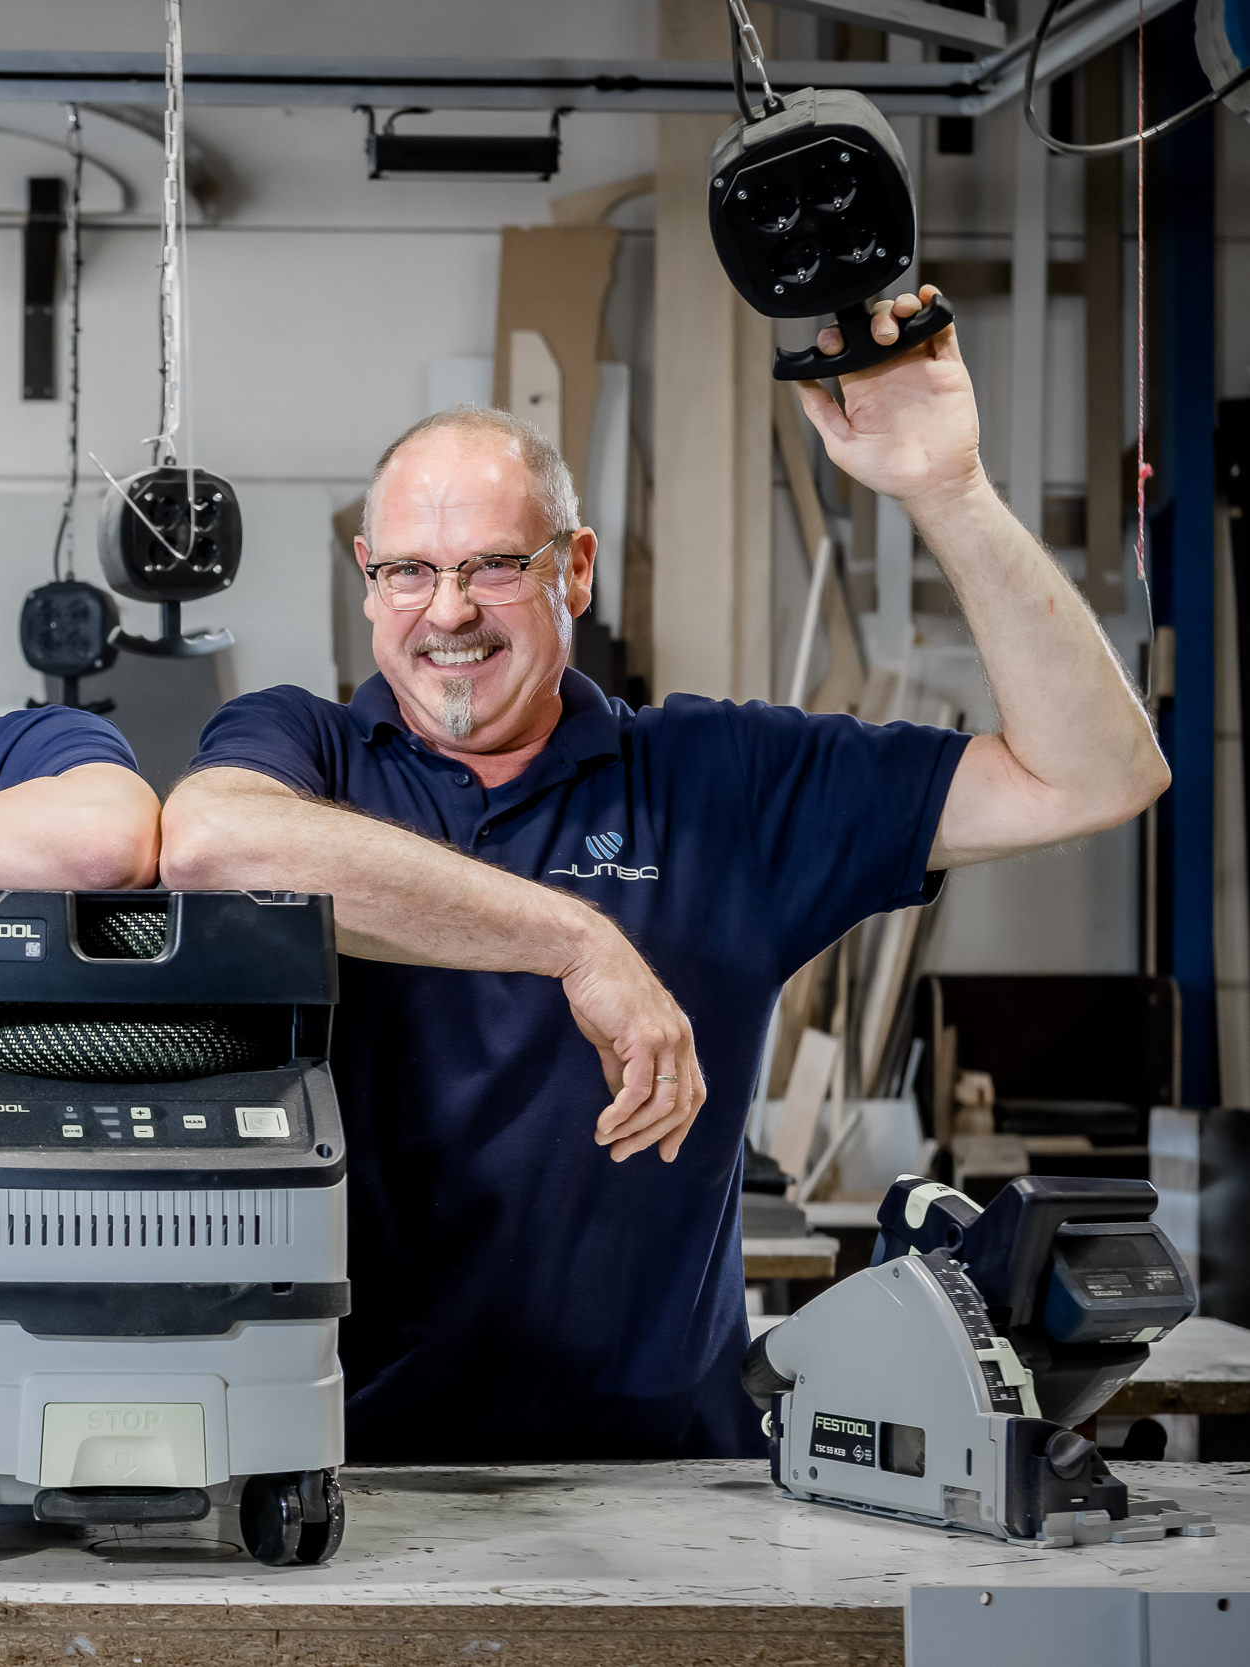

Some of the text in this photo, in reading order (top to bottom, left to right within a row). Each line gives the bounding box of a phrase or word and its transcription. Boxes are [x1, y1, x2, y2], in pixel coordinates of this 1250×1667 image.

[549, 863, 659, 881] JUMBO
[88, 1410, 162, 1431] STOP
[815, 1415, 873, 1438] FESTOOL
[814, 1443, 827, 1453] TSC
